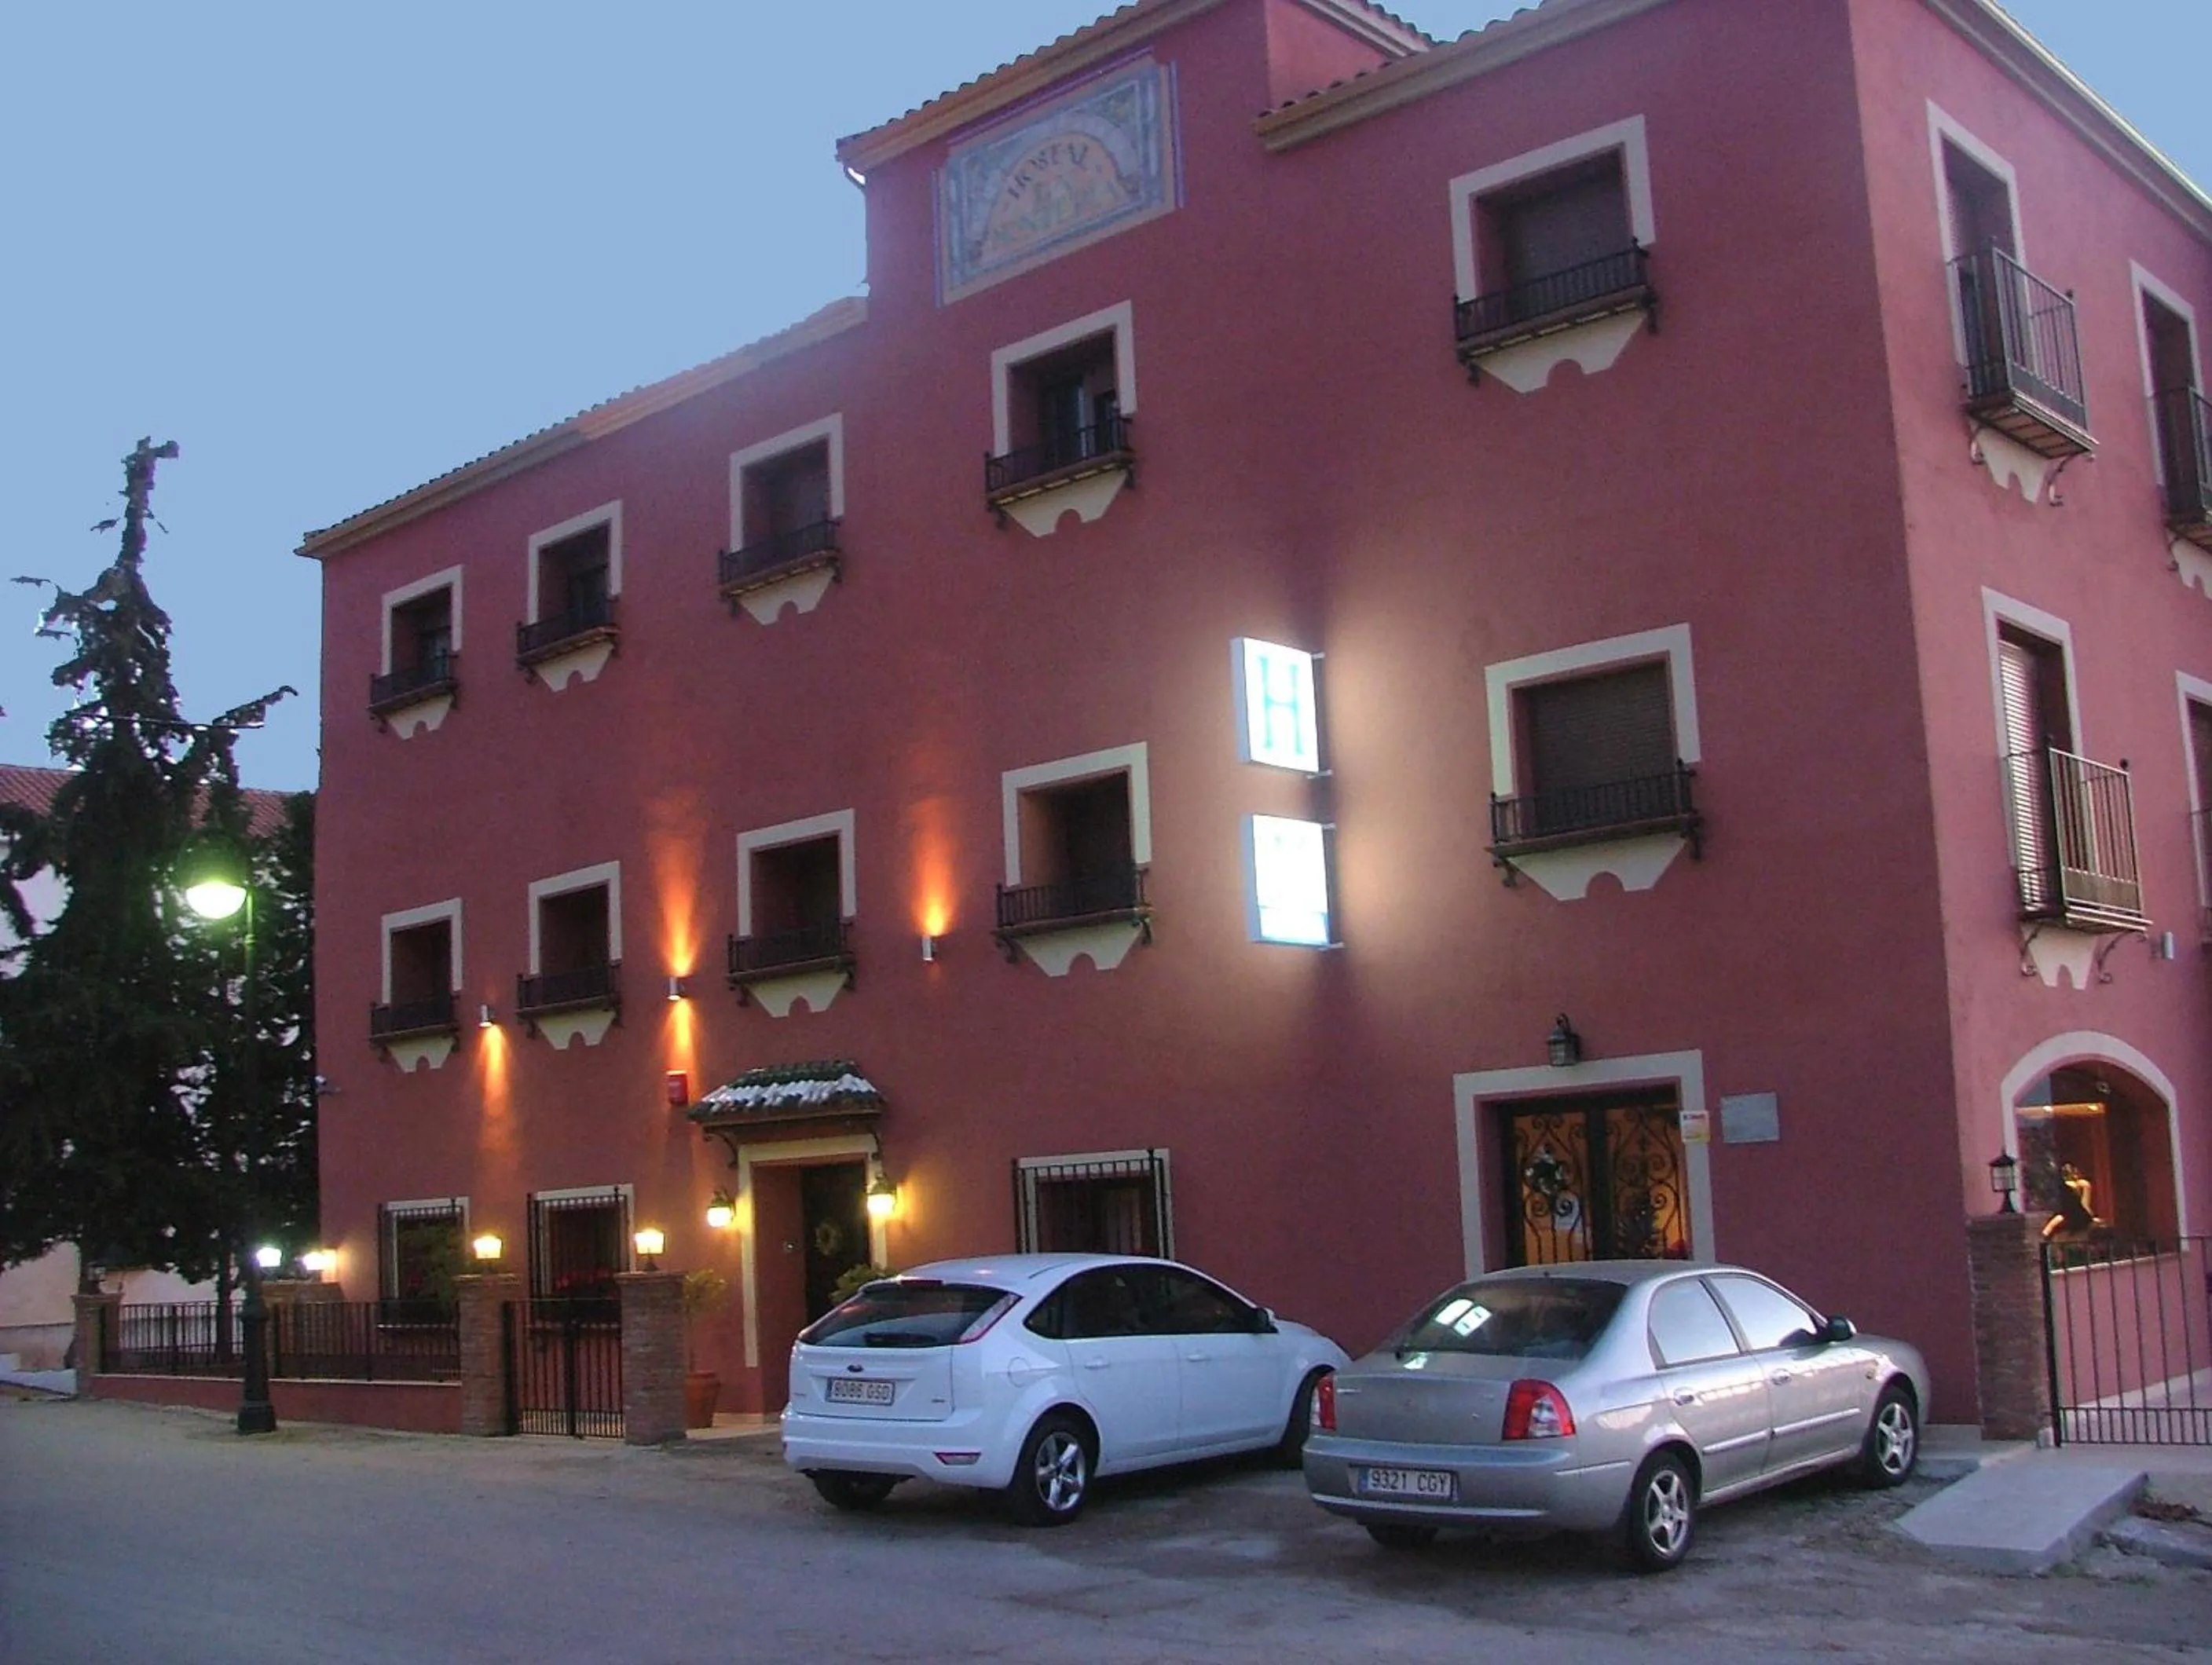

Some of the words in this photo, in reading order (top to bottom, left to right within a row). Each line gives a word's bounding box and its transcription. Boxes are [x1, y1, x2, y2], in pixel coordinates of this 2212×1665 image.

[1258, 655, 1304, 755] H
[1372, 1469, 1407, 1490] 9321
[1417, 1472, 1447, 1491] CGY
